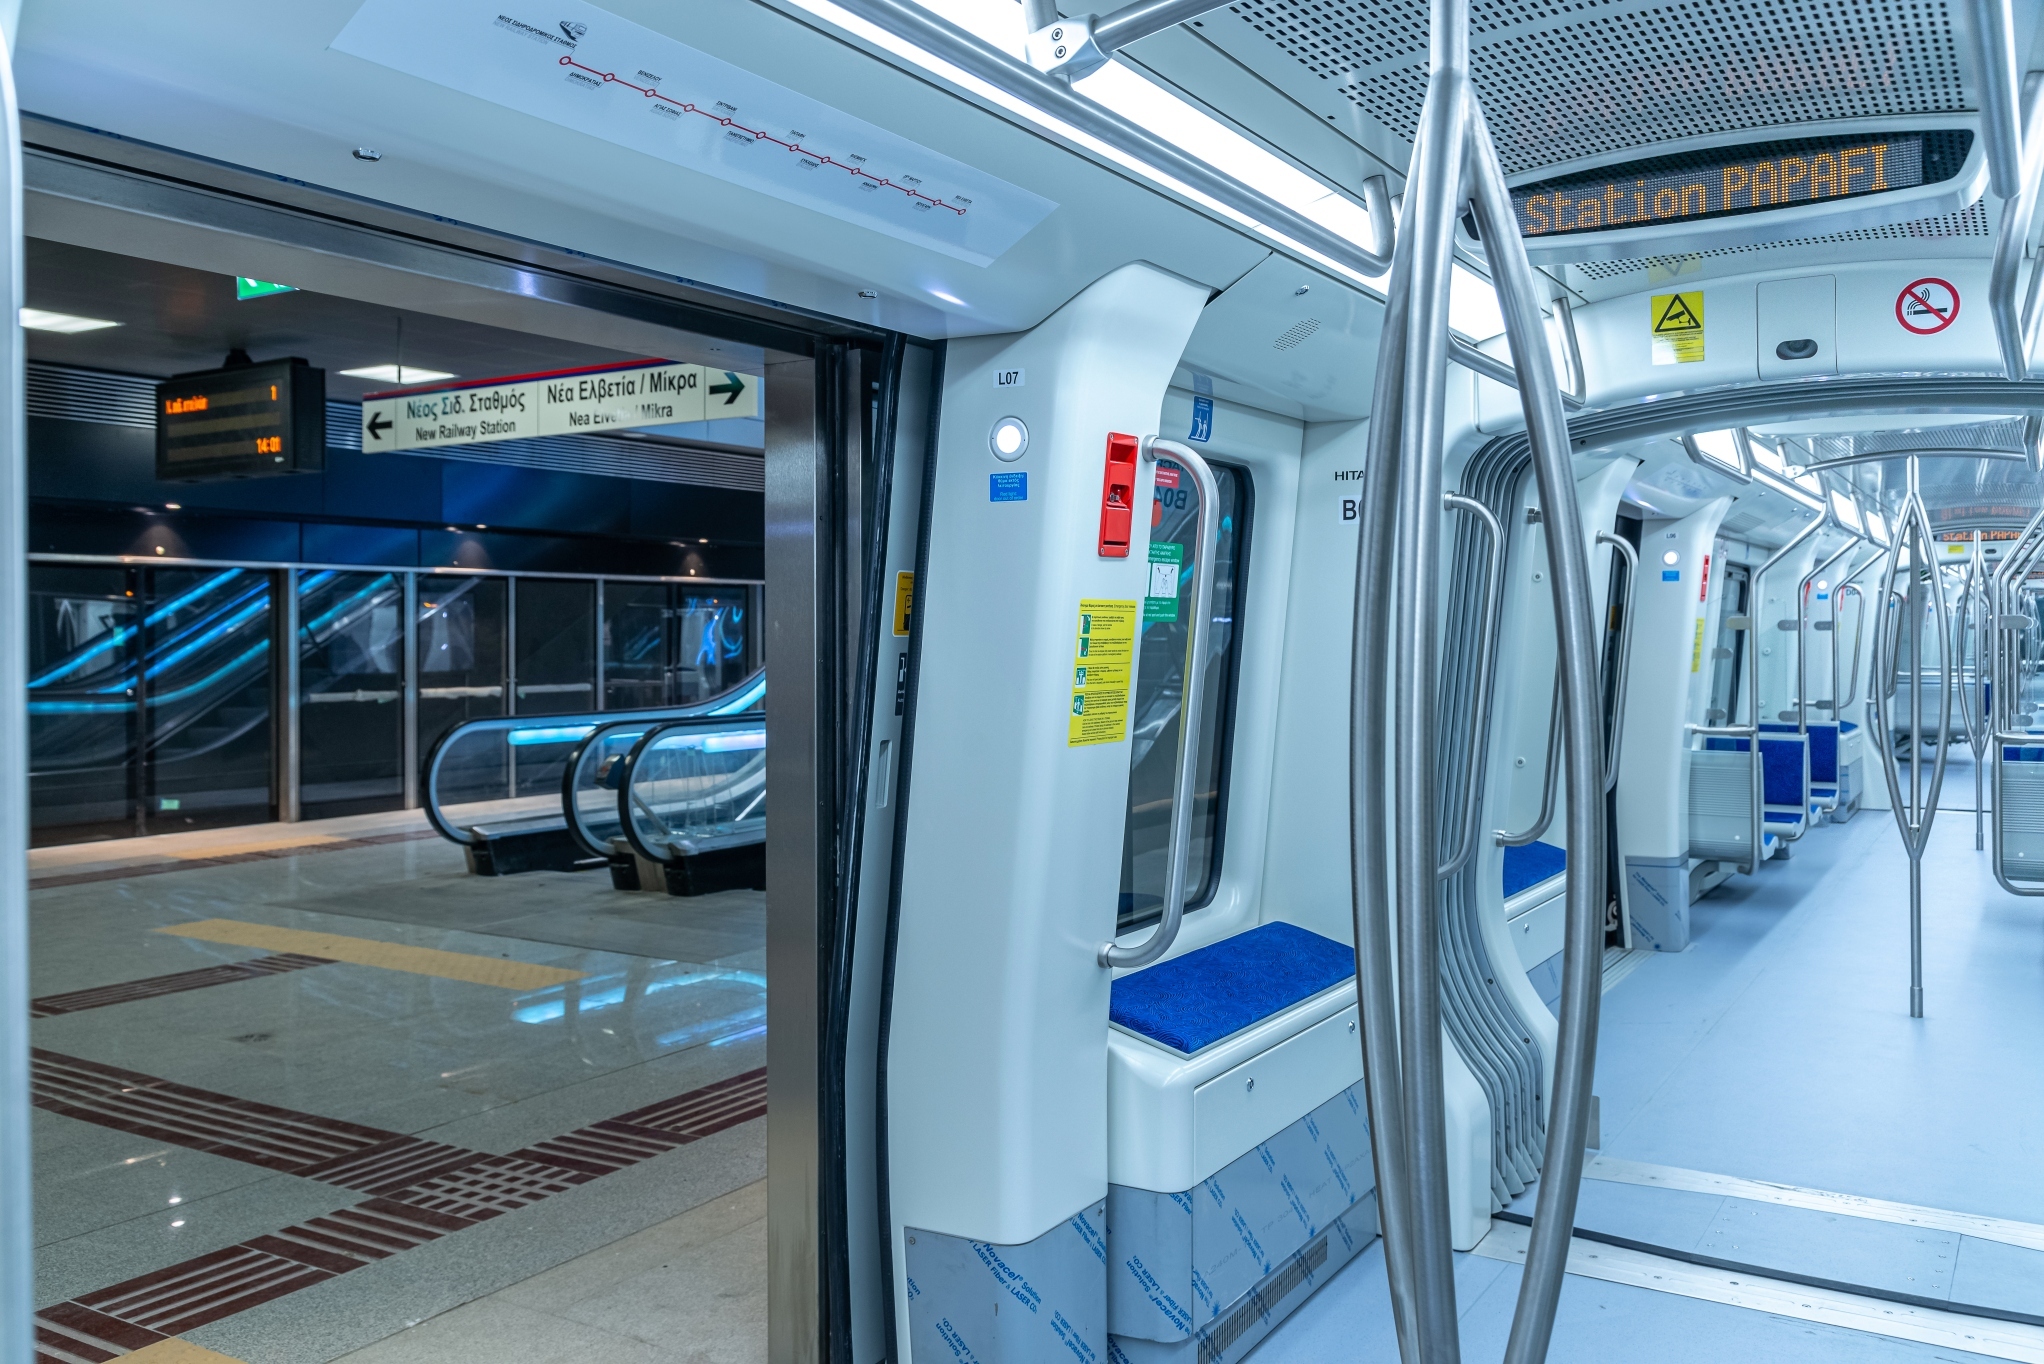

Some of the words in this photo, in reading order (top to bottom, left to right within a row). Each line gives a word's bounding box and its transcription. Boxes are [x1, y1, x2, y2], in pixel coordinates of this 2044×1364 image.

[1526, 178, 1709, 236] Station
[1722, 145, 1889, 209] PAPAFI
[547, 383, 574, 404] Νέα
[579, 375, 635, 404] Ελβετία
[650, 370, 697, 395] Μίκρα
[998, 371, 1019, 386] L07
[406, 400, 438, 421] Νέος
[441, 395, 465, 416] Σιδ.
[469, 388, 525, 413] Σταθμός
[569, 411, 590, 427] Nea
[641, 404, 673, 421] Mikra
[415, 427, 437, 442] New
[438, 423, 477, 440] Railway
[480, 420, 516, 435] Station
[1334, 470, 1365, 481] HITA
[973, 1244, 991, 1267] LASER
[991, 1267, 1007, 1284] Fiber
[1011, 1287, 1030, 1306] LASER
[1127, 1261, 1150, 1292] Solution
[1142, 1269, 1160, 1291] LASER
[1022, 1282, 1041, 1304] Solution
[1163, 1295, 1179, 1310] Fiber
[936, 1323, 964, 1356] Solution
[952, 1332, 970, 1355] LASER
